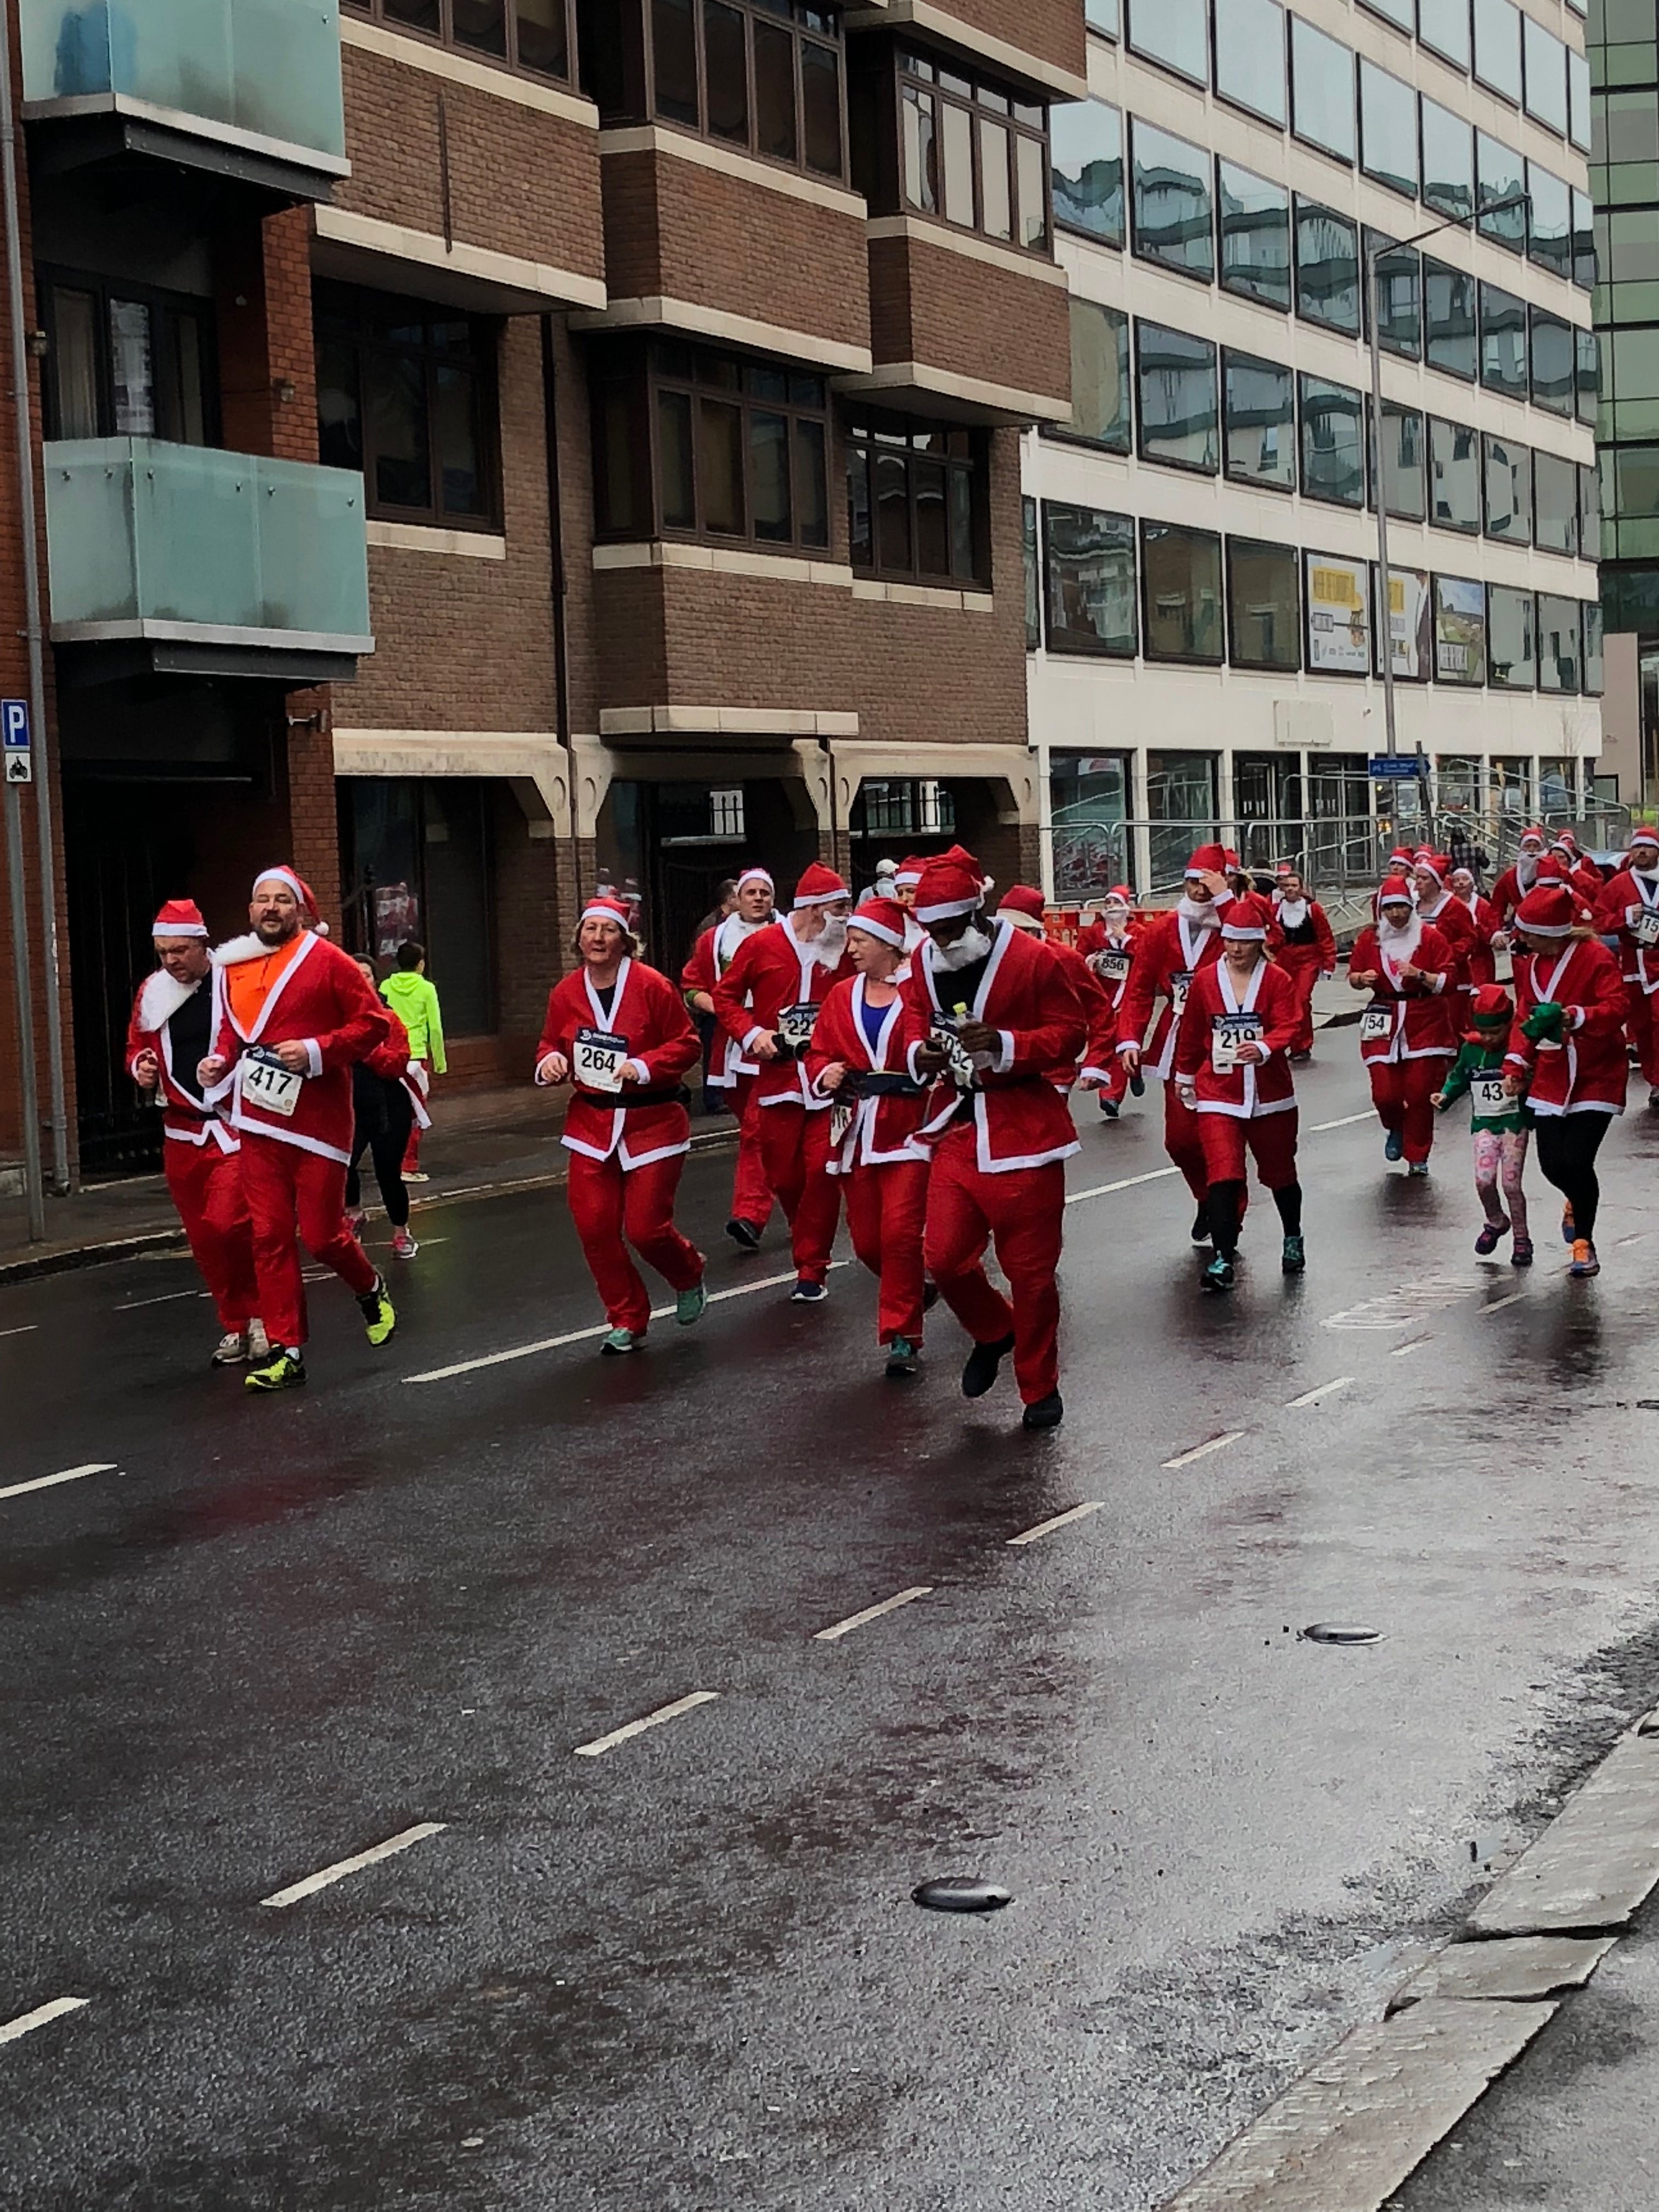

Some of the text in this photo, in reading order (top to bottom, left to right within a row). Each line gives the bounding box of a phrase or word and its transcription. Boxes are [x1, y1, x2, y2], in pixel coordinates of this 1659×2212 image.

[8, 706, 24, 743] P
[582, 1047, 616, 1074] 264
[249, 1065, 293, 1095] 417
[1482, 1082, 1503, 1101] 43
